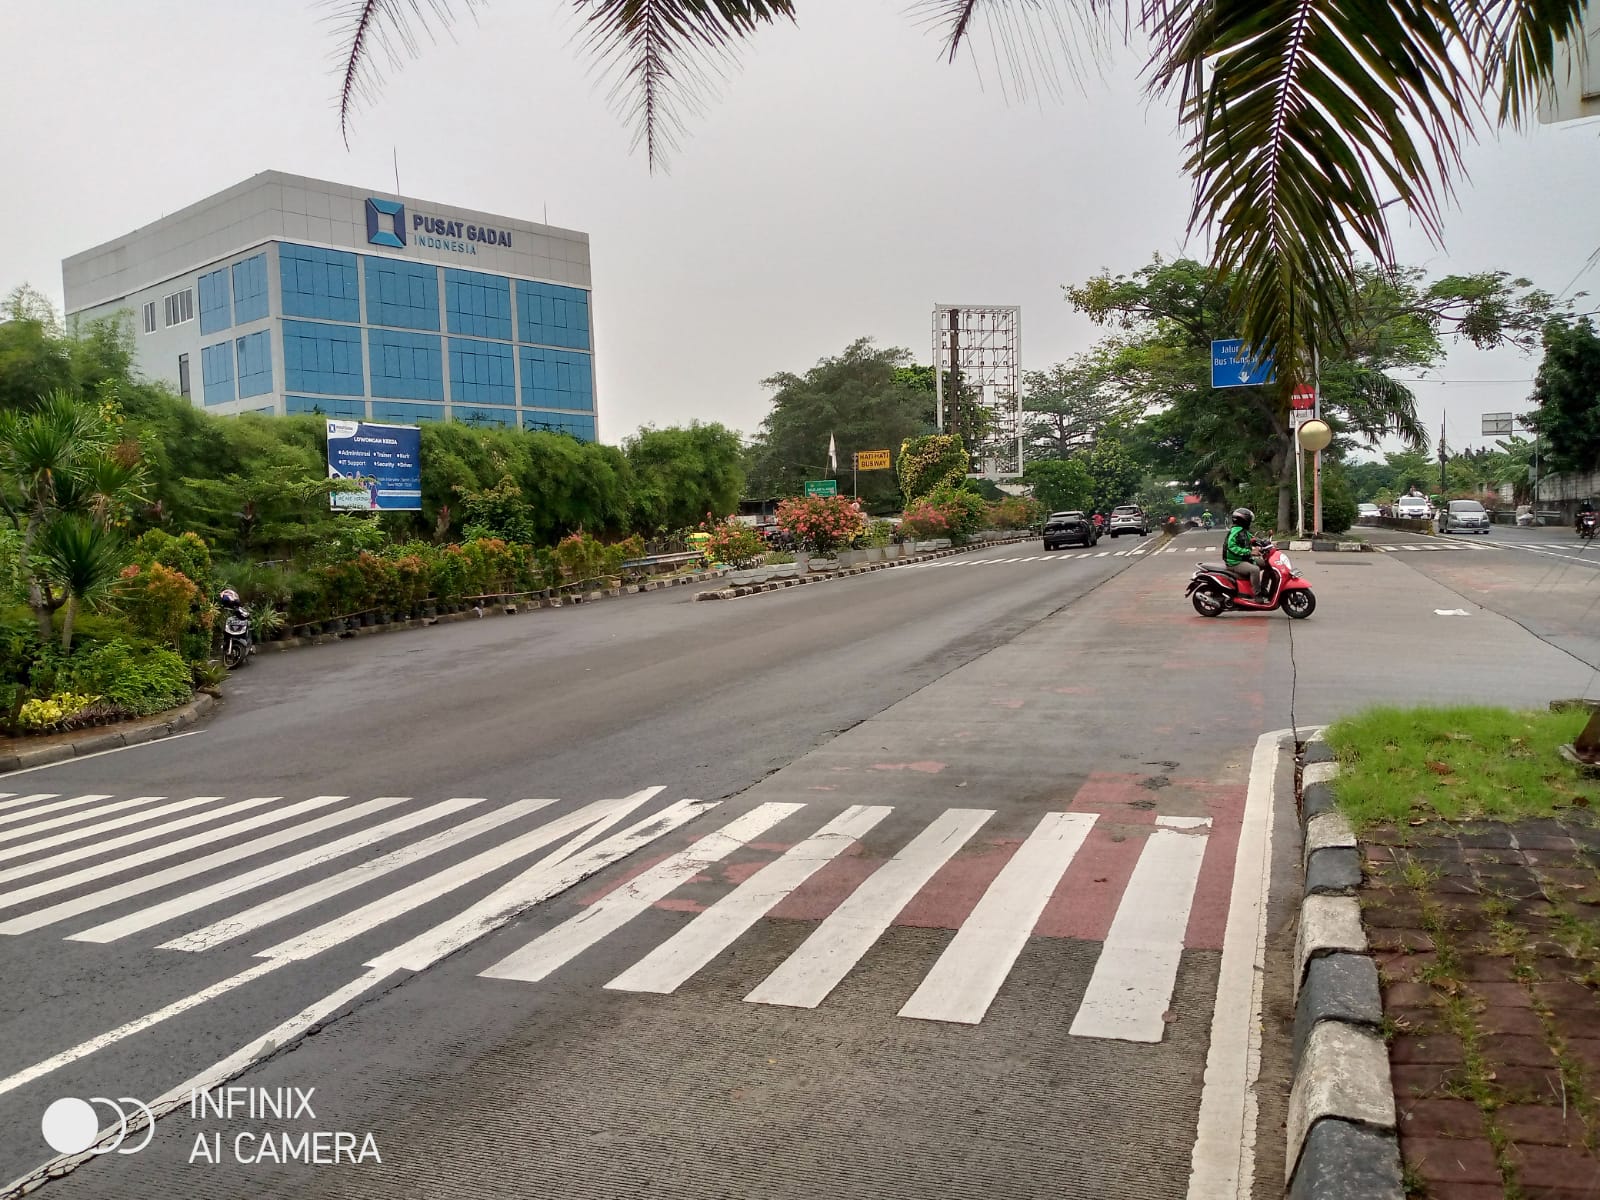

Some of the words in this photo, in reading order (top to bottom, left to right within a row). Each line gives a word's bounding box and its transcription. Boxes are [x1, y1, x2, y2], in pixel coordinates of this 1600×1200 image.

[413, 214, 464, 238] PUSAT
[466, 224, 512, 248] GADAI
[414, 235, 477, 255] INDONESIA
[1214, 358, 1227, 366] Bus
[376, 461, 395, 469] Security
[861, 460, 886, 468] BUSWAY
